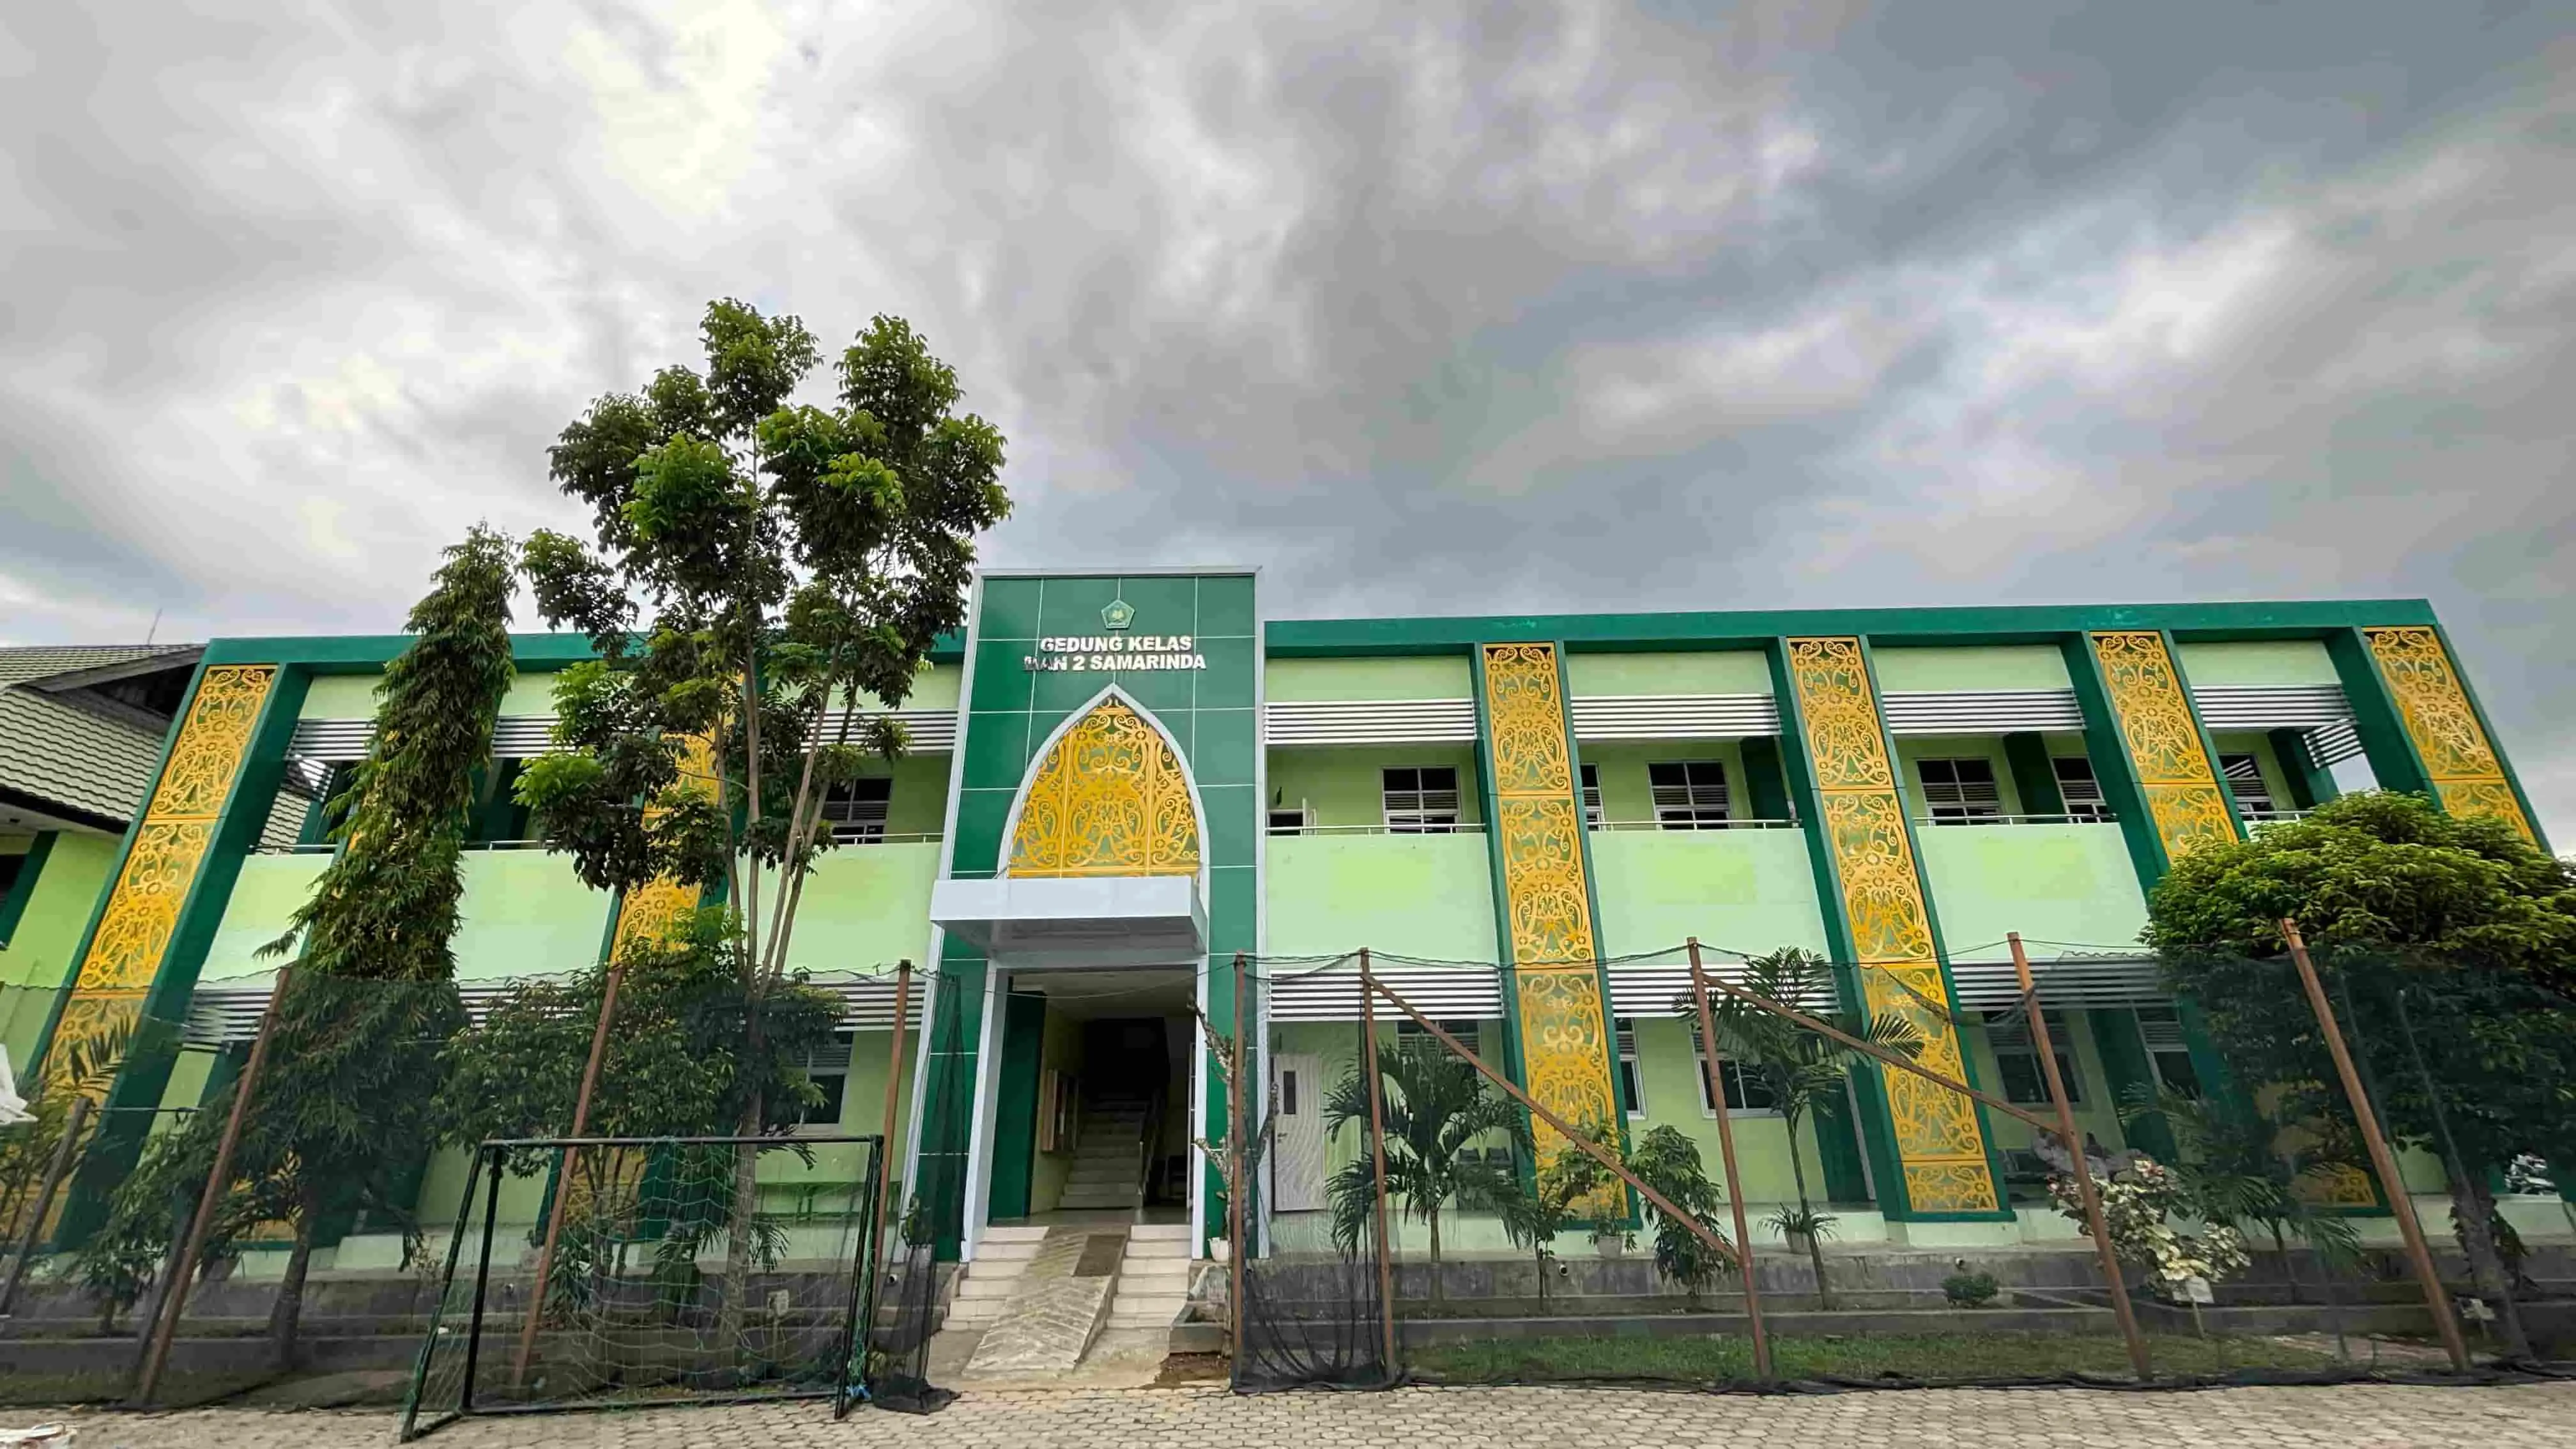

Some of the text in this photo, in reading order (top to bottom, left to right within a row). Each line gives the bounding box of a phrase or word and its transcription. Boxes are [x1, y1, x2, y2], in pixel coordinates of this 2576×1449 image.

[1041, 636, 1192, 652] GEDUNG KELAS
[1073, 655, 1085, 670] 2
[1090, 654, 1206, 670] SAMARINDA
